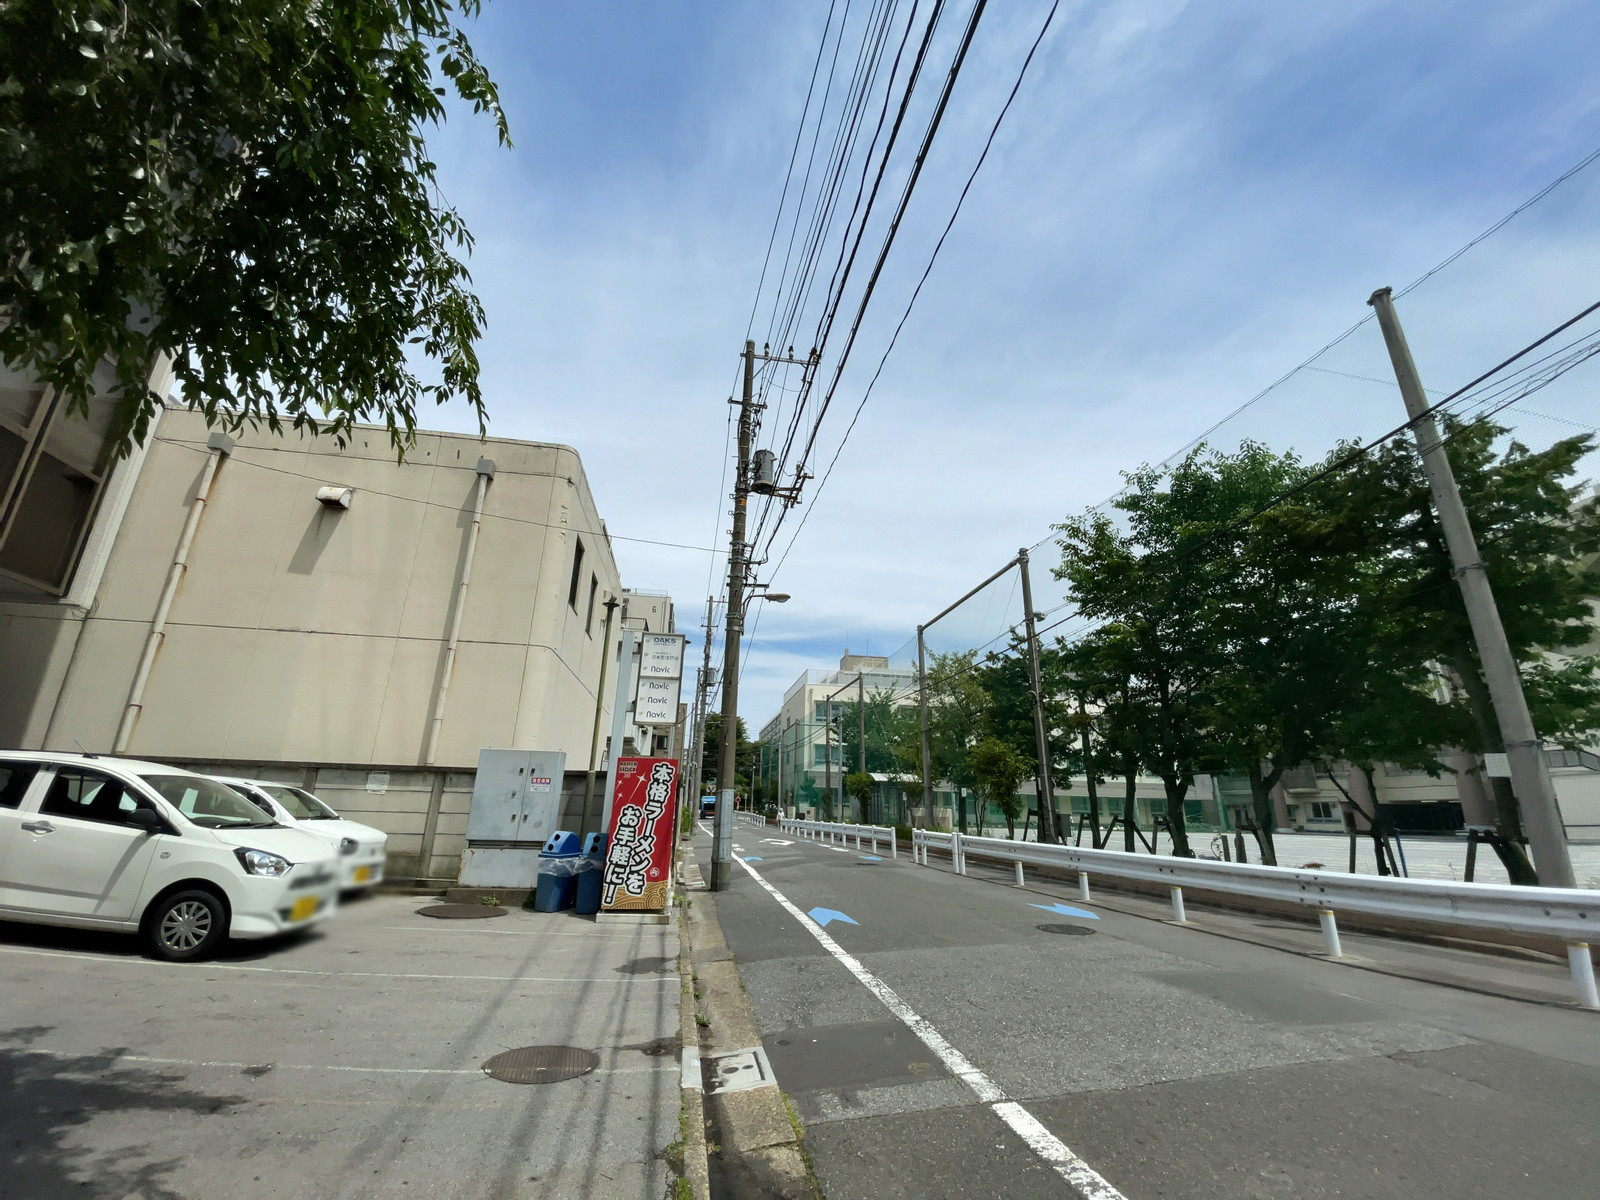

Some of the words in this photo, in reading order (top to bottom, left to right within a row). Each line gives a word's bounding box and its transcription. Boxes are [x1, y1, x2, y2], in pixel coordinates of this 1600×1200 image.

[625, 762, 675, 895] 本格ラーメンを
